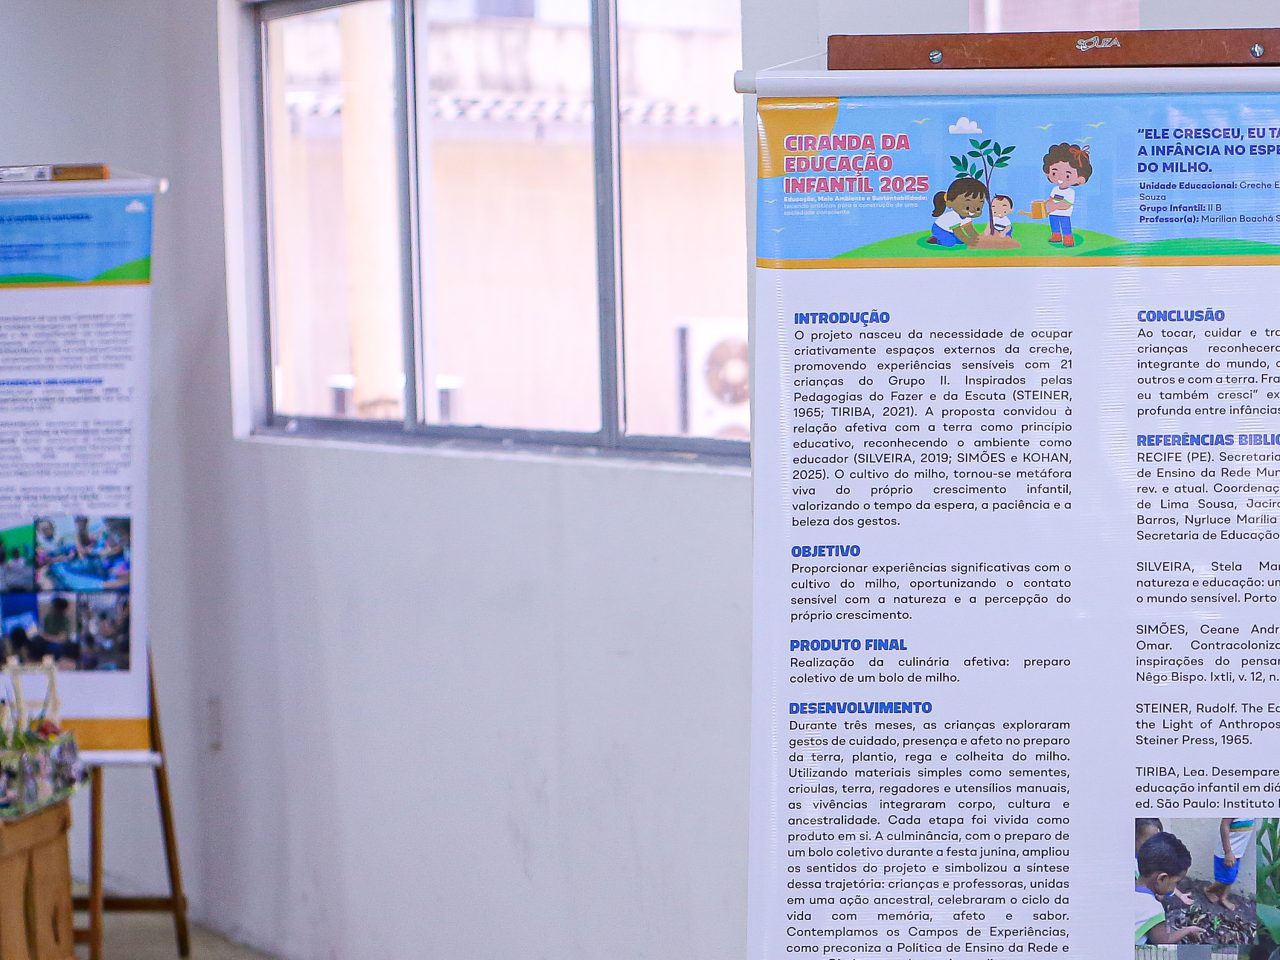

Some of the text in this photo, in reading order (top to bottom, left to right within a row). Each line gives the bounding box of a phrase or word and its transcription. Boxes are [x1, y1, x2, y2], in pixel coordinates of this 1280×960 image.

[1172, 127, 1245, 142] CRESCEU,
[1247, 127, 1266, 138] EU
[784, 134, 911, 152] CIRANDA DA
[1136, 145, 1149, 157] A
[1150, 141, 1222, 157] INFÂNCIA
[1223, 144, 1247, 156] NO
[785, 151, 893, 177] EDUCAÇÃO
[1137, 161, 1213, 174] DO MILHO.
[785, 176, 929, 193] INFANTIL 2025
[1138, 181, 1178, 190] Unidade
[1178, 180, 1238, 190] Educacional:
[1239, 180, 1273, 190] Creche
[1139, 192, 1167, 201] Souza
[1139, 204, 1168, 213] Grupo
[1170, 203, 1206, 212] Infantil:
[1215, 204, 1222, 212] B
[1139, 215, 1199, 224] Professor(a):
[794, 308, 891, 328] INTRODUÇÃO
[1137, 307, 1226, 323] CONCLUSÃO
[794, 327, 1074, 343] O projeto nasceu da necessidade de ocupar
[1137, 343, 1189, 356] crianças
[793, 358, 1073, 374] promovendo experiências sensíveis com 21
[1136, 431, 1235, 447] REFERÊNCIAS
[792, 449, 1072, 465] educador (SILVEIRA, 2019; SIMÕES e KOHAN,
[1137, 451, 1183, 463] RECIFE
[1186, 450, 1215, 464] (PE).
[790, 544, 861, 558] OBJETIVO
[791, 561, 1072, 576] Proporcionar experiências significativas com o
[1136, 561, 1195, 574] SILVEIRA,
[1210, 560, 1243, 572] Stela
[1135, 621, 1189, 637] SIMÕES,
[1199, 623, 1240, 635] Ceane
[789, 638, 908, 652] PRODUTO FINAL
[790, 655, 1071, 670] Realização da culinária afetiva: preparo
[788, 701, 933, 715] DESENVOLVIMENTO
[1135, 718, 1156, 730] the
[1162, 718, 1194, 732] Light
[1199, 718, 1213, 730] of
[788, 766, 1070, 780] Utilizando materiais simples como sementes,
[1135, 798, 1154, 809] ed.
[1156, 798, 1180, 809] São
[1182, 797, 1220, 809] Paulo:
[1223, 797, 1275, 809] Instituto
[786, 925, 1070, 940] Contemplamos os Campos de Experiências,
